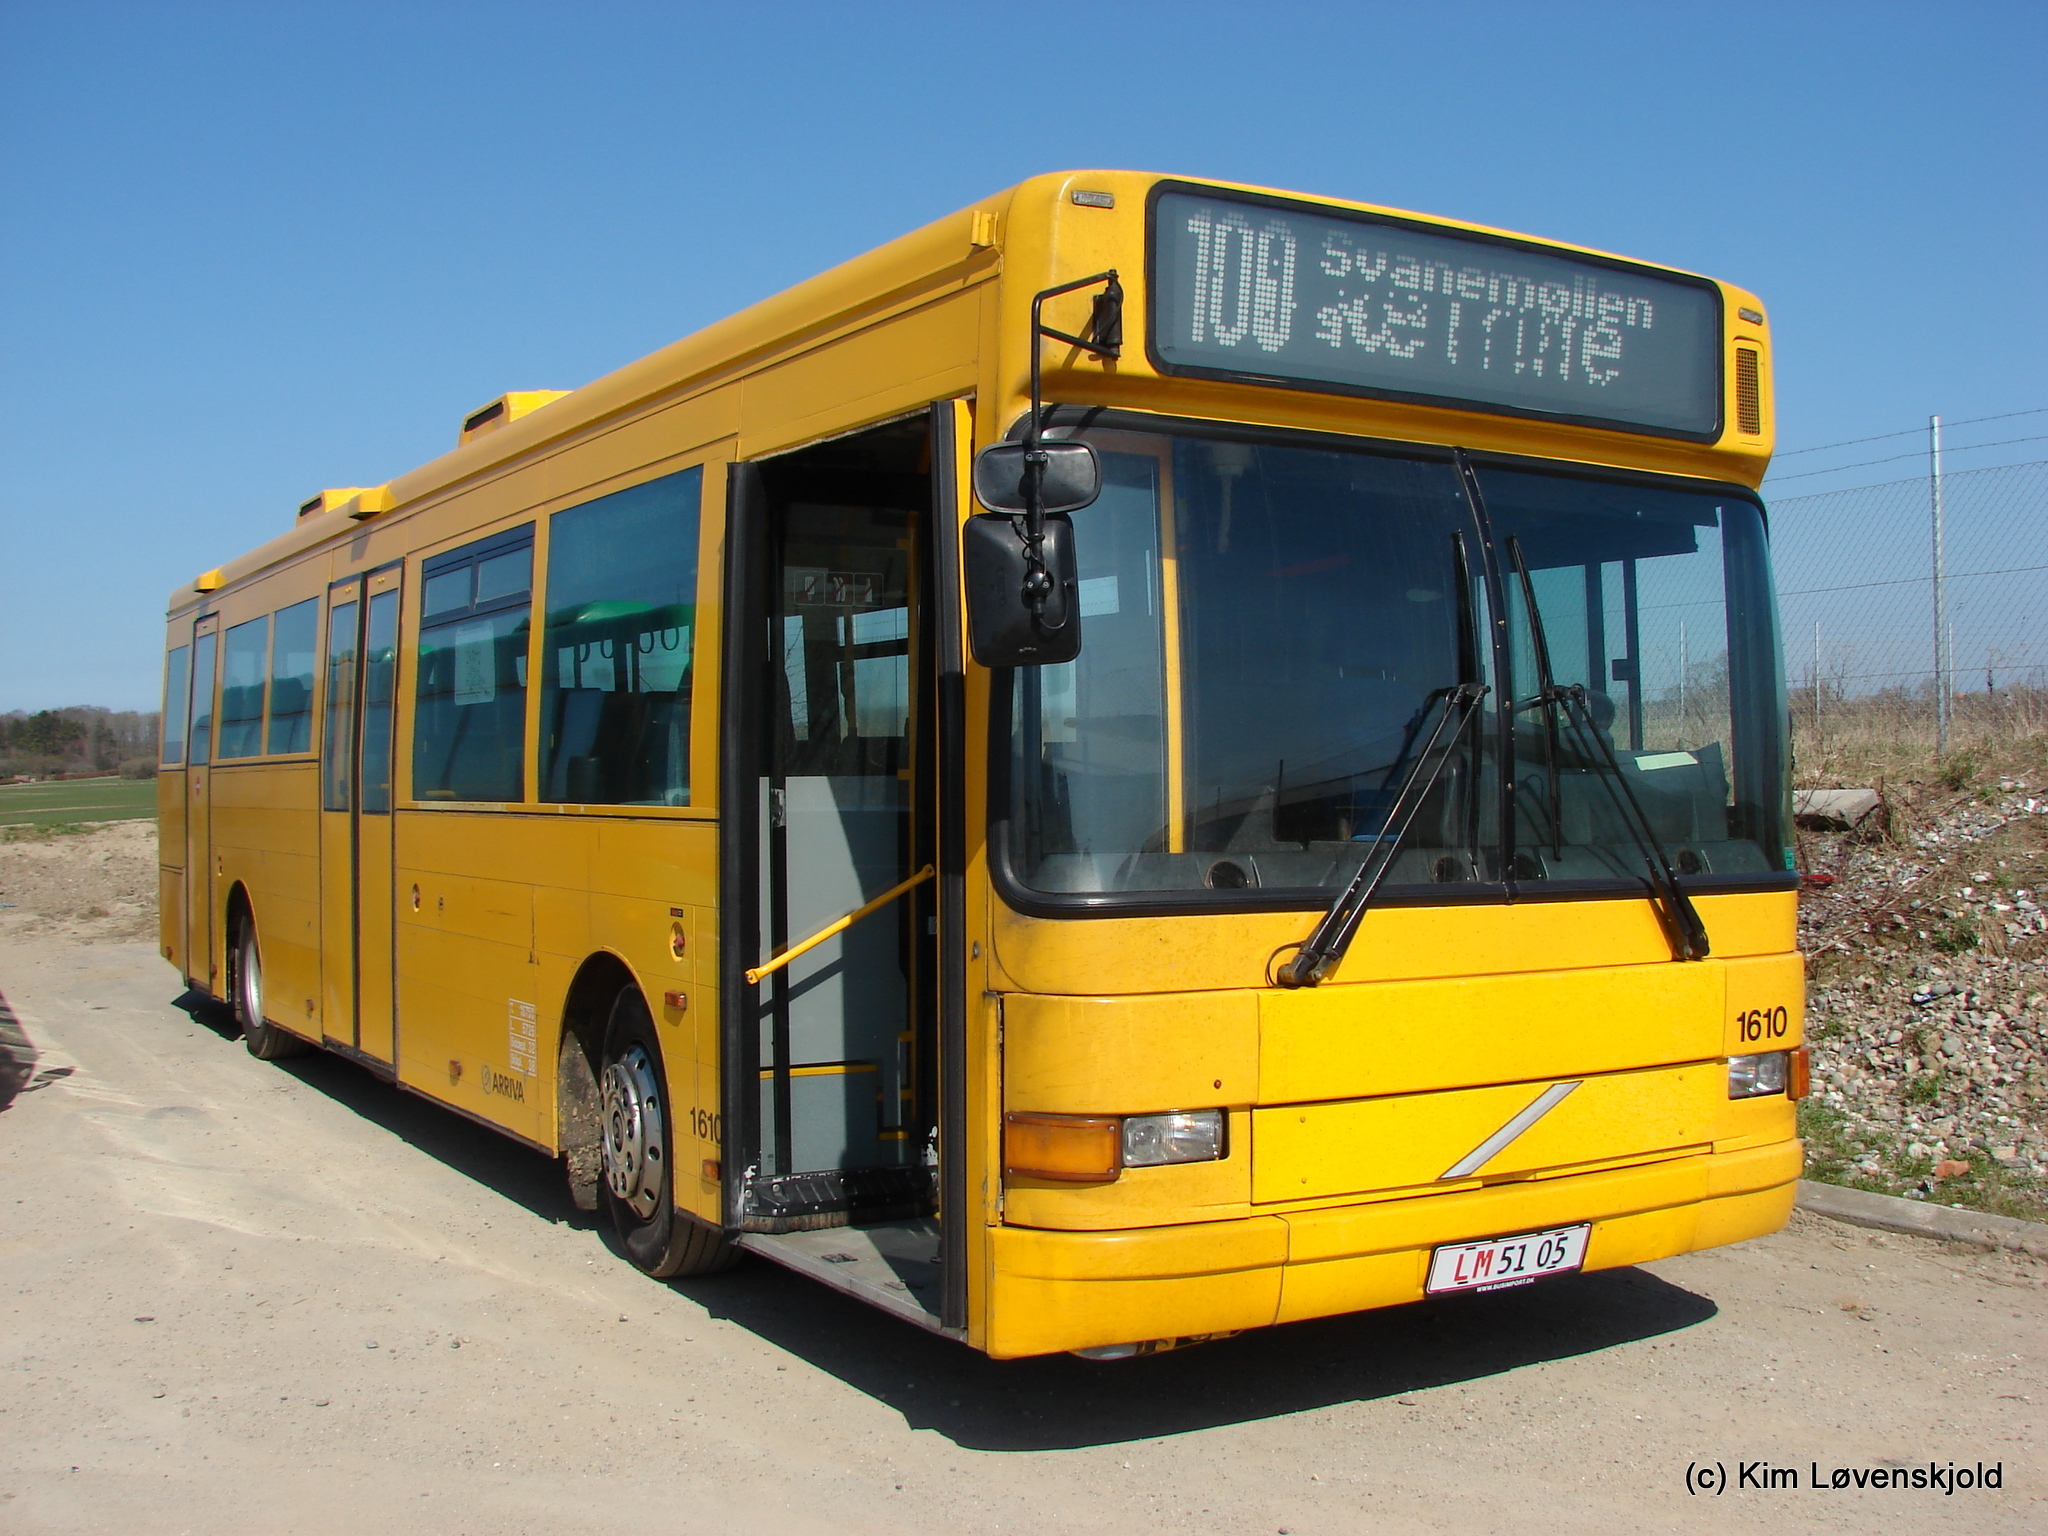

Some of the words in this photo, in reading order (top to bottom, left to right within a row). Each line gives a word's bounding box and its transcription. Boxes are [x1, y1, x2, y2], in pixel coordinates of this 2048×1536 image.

[1736, 1006, 1787, 1042] 1610
[492, 1072, 525, 1104] ARRIVA
[690, 1106, 722, 1145] 1610
[1454, 1249, 1495, 1282] LM
[1497, 1244, 1527, 1274] 51
[1537, 1236, 1568, 1268] 05
